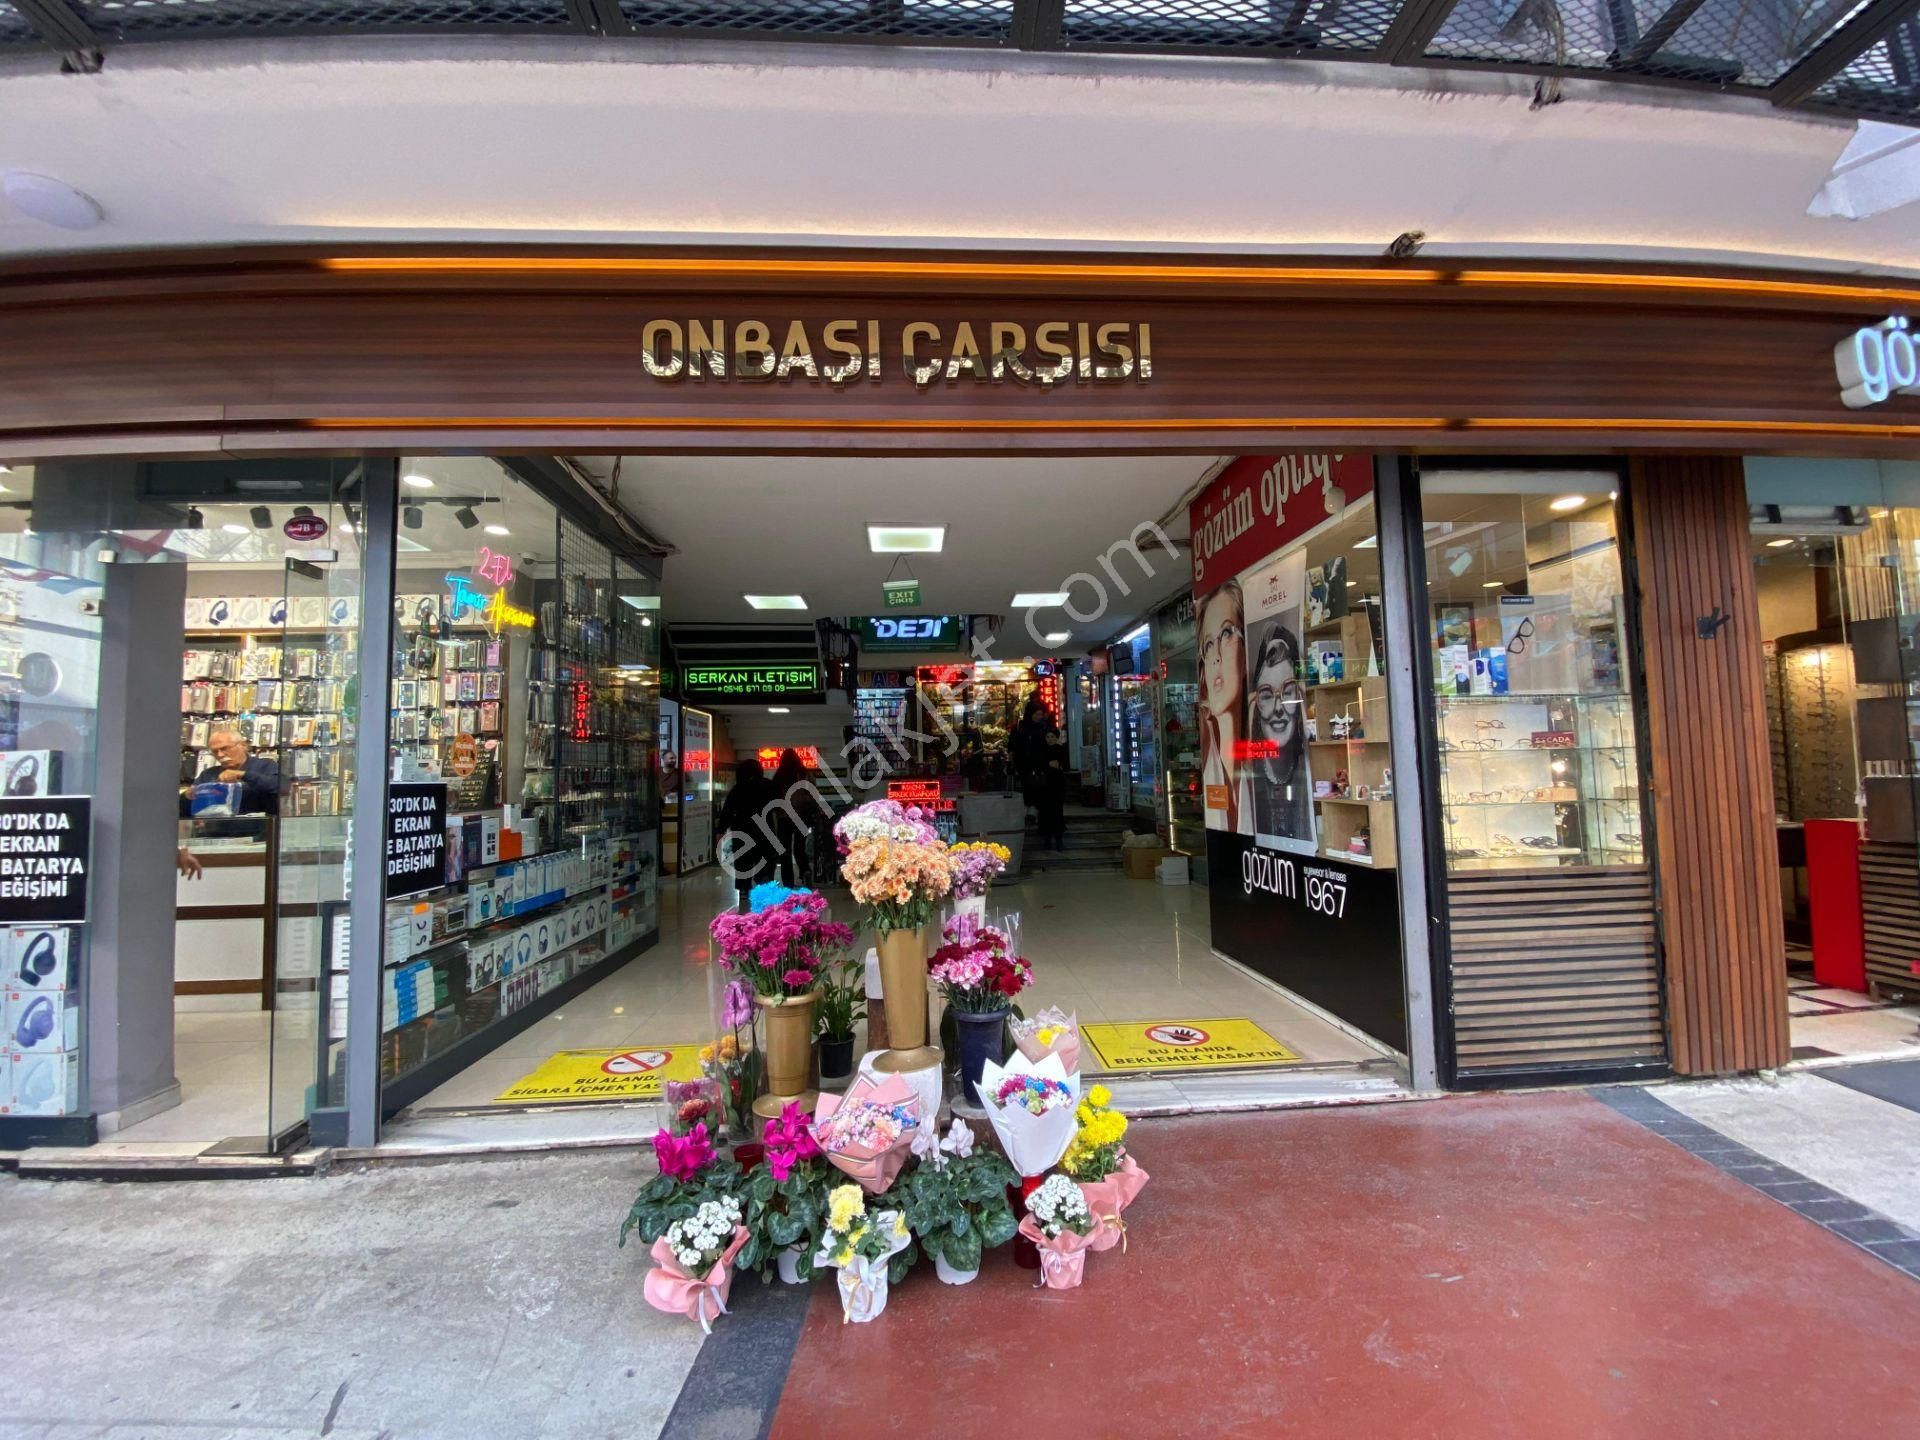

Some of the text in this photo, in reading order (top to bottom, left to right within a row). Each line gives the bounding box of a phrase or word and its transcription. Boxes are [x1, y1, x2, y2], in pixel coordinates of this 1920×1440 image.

[642, 318, 1153, 387] ONBAŞI ÇARŞISI
[1194, 485, 1255, 582] gözüm
[888, 590, 915, 599] EXIT
[1261, 591, 1288, 609] MOREL
[688, 671, 748, 684] SERKAN
[390, 796, 436, 813] 30'DK DA
[0, 813, 70, 830] 0'DK DA
[394, 815, 431, 833] EKRAN
[0, 835, 60, 853] EKRAN
[387, 833, 444, 855] E BATARYA
[1, 857, 84, 875] BATARYA
[388, 849, 435, 876] DEĞİŞİMİ
[1242, 847, 1296, 899] gözüm
[0, 875, 68, 900] EĞİŞİMİ
[1304, 877, 1347, 918] 1967
[1115, 1050, 1284, 1065] BEKLEMEK YASAKTIR
[1174, 1045, 1238, 1055] ALANDA
